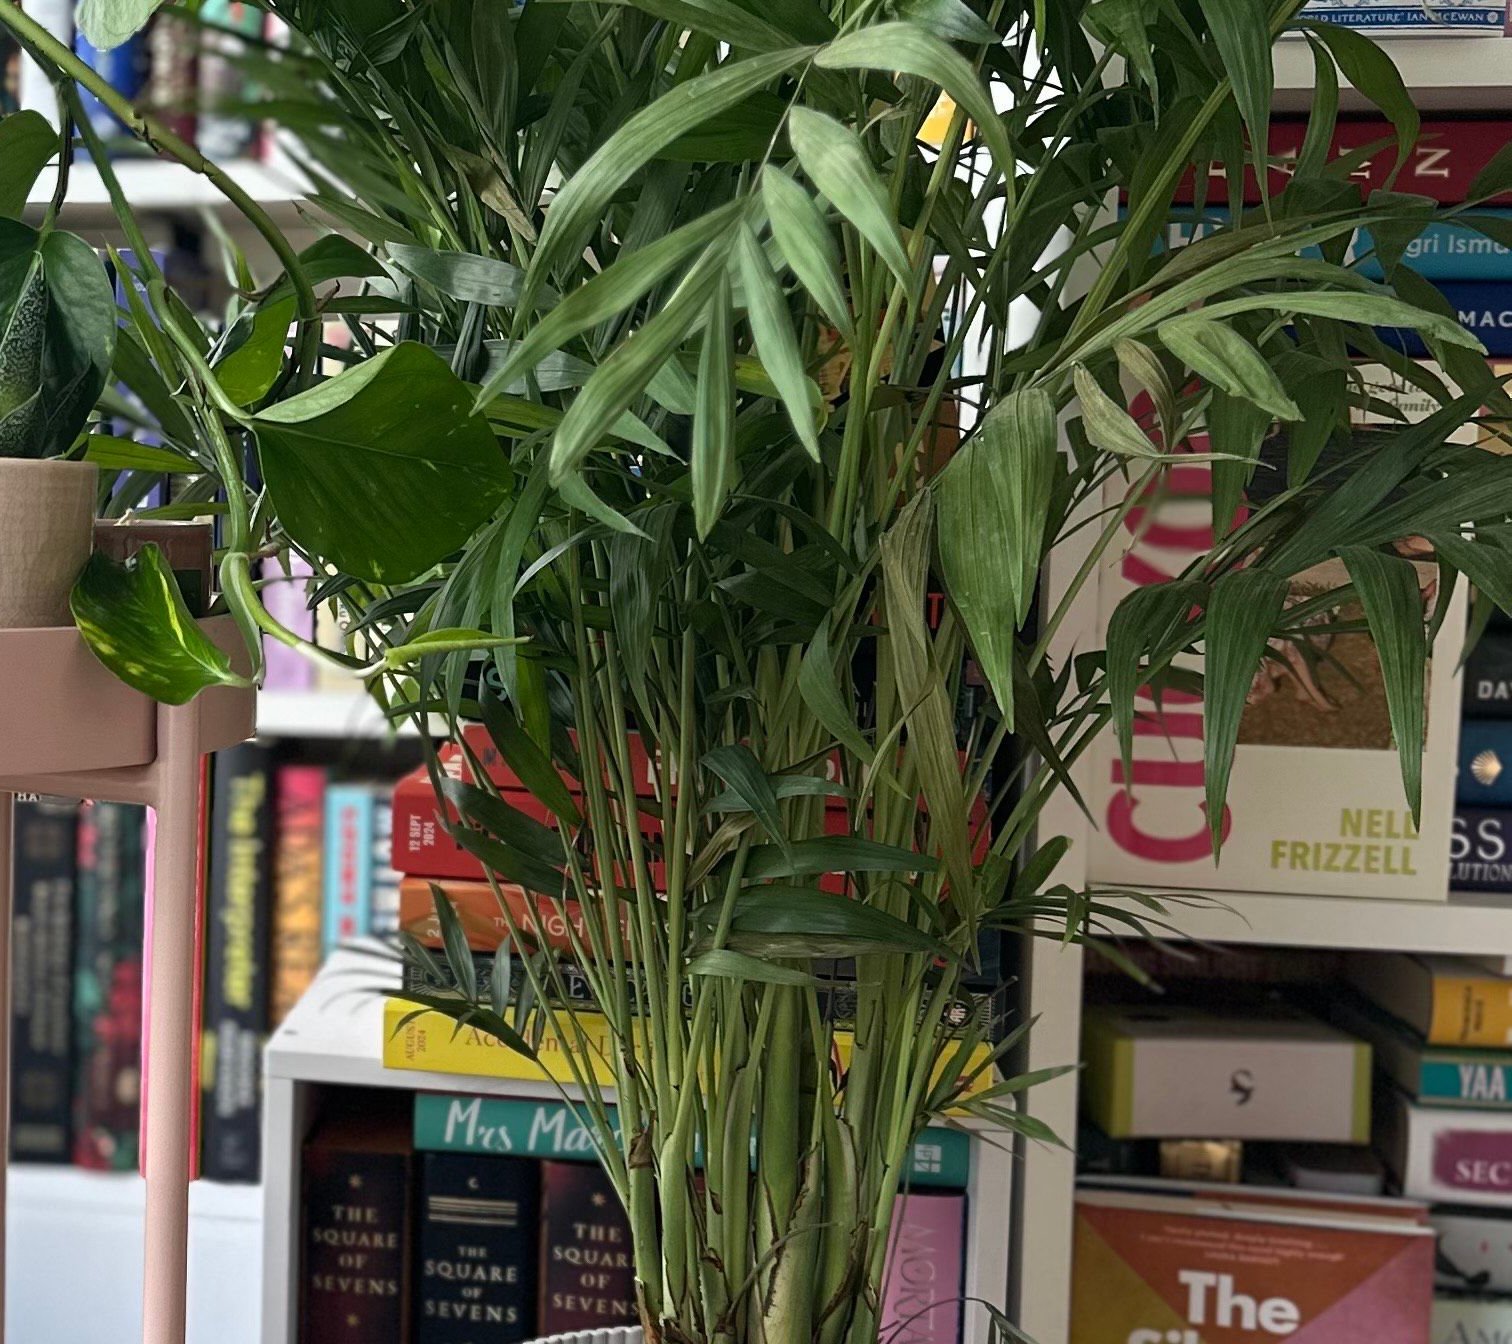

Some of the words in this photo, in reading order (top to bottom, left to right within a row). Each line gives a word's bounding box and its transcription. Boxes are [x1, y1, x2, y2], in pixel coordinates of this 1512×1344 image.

[1406, 233, 1439, 258] gri
[409, 814, 422, 837] SEPT
[423, 820, 434, 846] 2024
[409, 837, 421, 852] 12
[1270, 840, 1418, 877] FRIZZELL
[1458, 1064, 1507, 1099] YAA
[444, 1097, 513, 1153] Mrs
[333, 1205, 379, 1223] THE
[312, 1227, 398, 1249] SQUARE
[574, 1223, 622, 1243] THE
[340, 1254, 366, 1269] OF
[458, 1246, 487, 1258] THE
[425, 1258, 518, 1284] SQUARE
[580, 1272, 611, 1291] OF
[312, 1275, 398, 1296] SEVENS
[462, 1285, 483, 1298] OF
[425, 1301, 518, 1323] SEVENS
[1178, 1270, 1301, 1335] The
